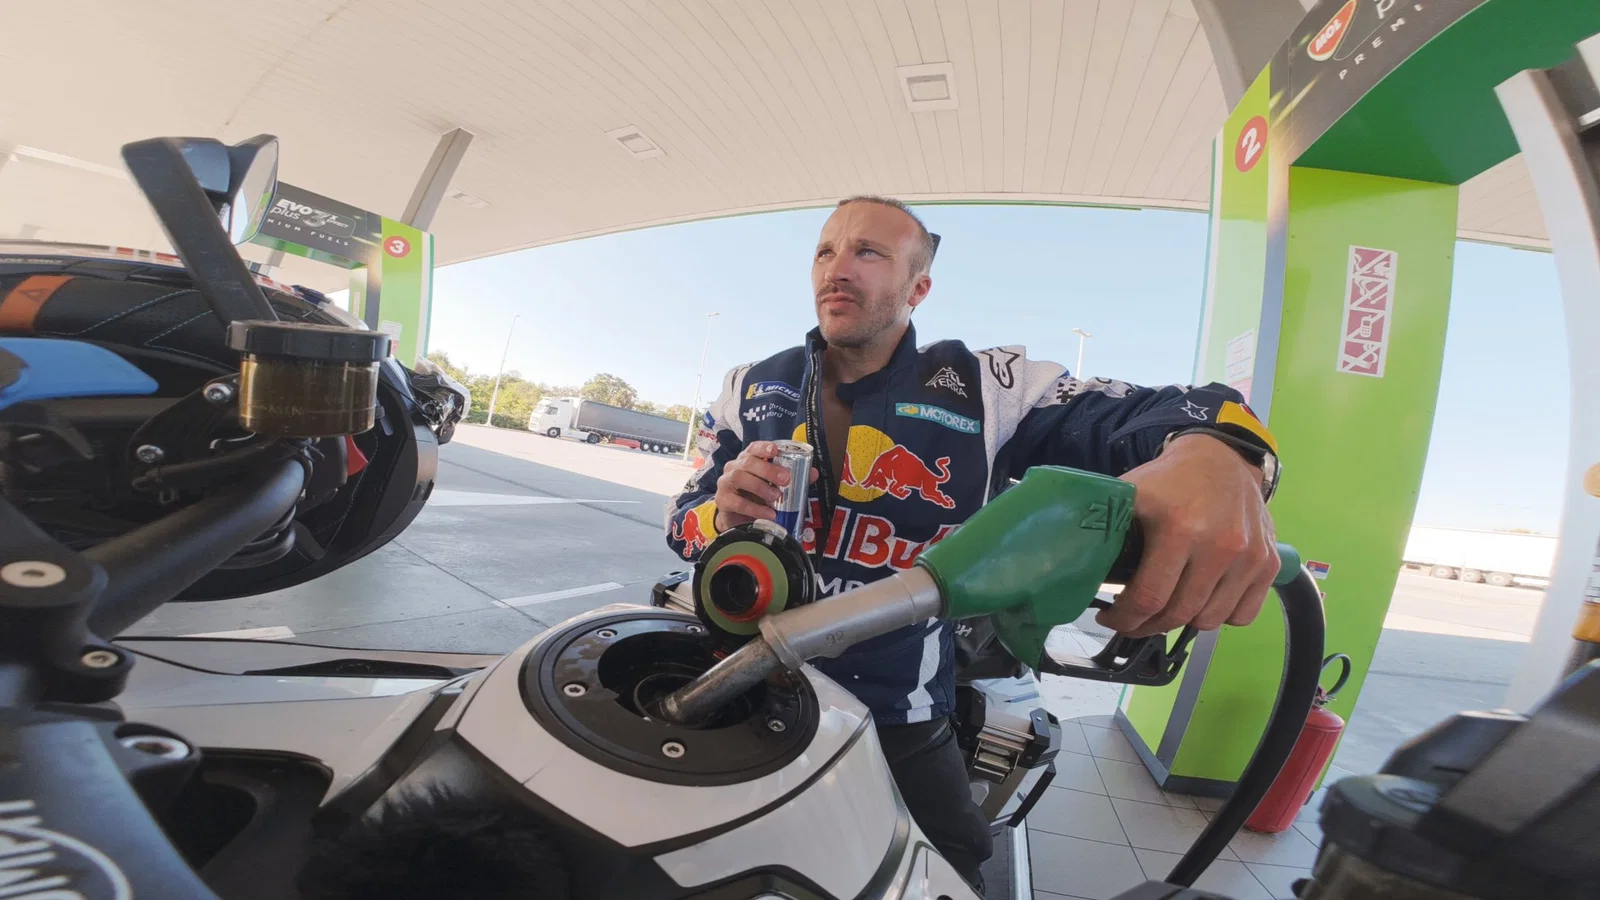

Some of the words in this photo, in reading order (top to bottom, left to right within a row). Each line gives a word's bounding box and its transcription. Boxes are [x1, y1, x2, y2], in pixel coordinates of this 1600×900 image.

[1314, 18, 1342, 52] MOL
[1338, 3, 1423, 80] PREMI
[1240, 126, 1261, 165] 2
[269, 206, 301, 220] plus
[276, 198, 313, 215] EVO
[266, 218, 301, 232] MIUM
[310, 230, 349, 246] FUELS
[389, 239, 405, 254] 3
[765, 384, 801, 399] MICHE
[931, 377, 968, 399] TERRA
[769, 402, 798, 418] Christop
[920, 405, 975, 432] MOTOREX
